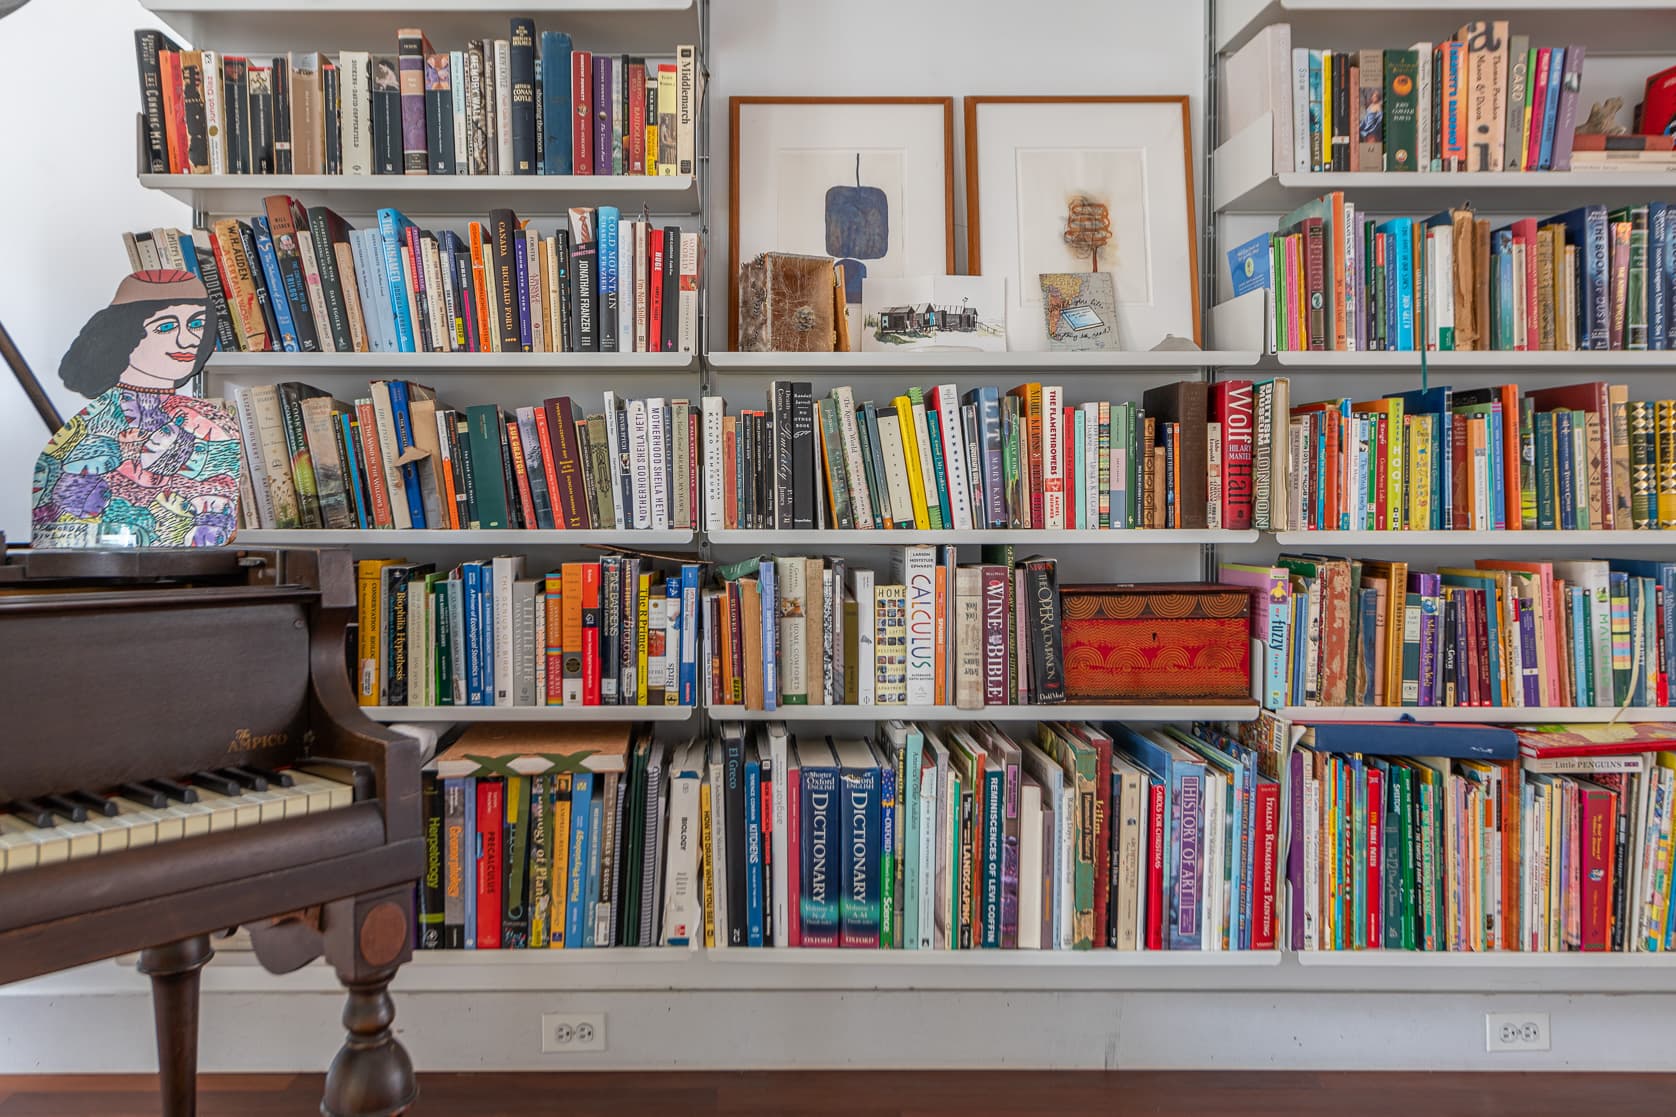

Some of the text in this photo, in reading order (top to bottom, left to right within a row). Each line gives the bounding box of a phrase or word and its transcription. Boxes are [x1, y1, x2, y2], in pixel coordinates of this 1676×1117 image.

[470, 54, 481, 122] MEMORY WALL
[681, 61, 691, 124] Middlemarch
[1448, 49, 1458, 144] GRAVITY'S RAINBOW
[1476, 55, 1485, 120] Mason & Dixon
[1492, 56, 1501, 120] Thomas Pynchon
[1512, 63, 1526, 102] CARD
[146, 72, 161, 150] THE CUNNING MAN
[383, 218, 400, 282] THE UNNAMED
[608, 216, 616, 309] COLD MOUNTAIN
[654, 252, 662, 271] HUGE
[1595, 223, 1605, 323] THE BOOK OF DUST
[202, 263, 228, 316] MIDDLESEX
[286, 274, 298, 301] TRILOGY
[498, 221, 513, 330] CANADA RICHARD FORD
[579, 260, 590, 332] JONATHAN FRANZEN
[333, 308, 341, 330] EGGERS
[638, 306, 646, 325] Stiller
[825, 409, 834, 434] johnson
[845, 410, 854, 432] Known
[984, 400, 1000, 441] LIT
[1049, 391, 1057, 406] THE
[1228, 385, 1252, 444] Wolf
[1264, 383, 1272, 444] BRITISH
[292, 402, 304, 452] COOKBOOK
[365, 425, 373, 437] THE
[367, 438, 375, 456] WIND
[510, 425, 524, 475] SUE GRAFTON
[778, 421, 792, 480] Pemberley
[849, 434, 857, 454] World
[370, 466, 378, 478] THE
[635, 413, 647, 522] MOTHERHOOD SHEILA HETI
[651, 408, 664, 516] MOTHERHOOD SHEILA HETI
[992, 456, 1001, 514] MARY KARR
[1228, 463, 1252, 504] Hall
[1543, 469, 1551, 498] LIGHTNING
[373, 479, 382, 507] WILLOWS
[778, 485, 786, 506] James
[1256, 446, 1270, 528] LONDON
[1543, 500, 1551, 516] THIEF
[609, 572, 619, 636] PINE BARRENS
[639, 588, 648, 599] The
[987, 583, 1004, 629] WINE
[524, 607, 533, 650] LITTLE
[623, 616, 636, 665] BIOLOGY
[639, 620, 648, 655] Primer
[912, 574, 931, 668] CALCULUS
[1038, 574, 1055, 680] THE OPERA COMPANION
[1269, 620, 1286, 651] fuzzy
[524, 656, 533, 682] LIFE
[665, 663, 674, 688] Birds
[987, 645, 1004, 698] BIBLE
[1447, 650, 1455, 669] Giver
[728, 747, 739, 789] El Greco
[807, 777, 835, 786] Oxford
[1555, 760, 1622, 770] Little PENGUINS
[680, 816, 688, 851] BIOLOGY
[704, 830, 712, 842] TO
[749, 823, 759, 864] KITCHENS
[812, 792, 829, 904] DICTIONARY
[851, 791, 868, 904] DICTIONARY
[1154, 786, 1164, 869] CAROLS FOR CHRISTMAS
[1182, 786, 1196, 896] HISTORY OF ART
[427, 817, 440, 888] Herpetology
[448, 826, 462, 897] Geomorphology
[487, 831, 495, 895] PRECALCULUS
[604, 857, 611, 867] OF
[987, 777, 998, 943] REMINISCENCES OF LEVI COFFIN
[1262, 797, 1275, 937] ITALIAN RENAISSANCE PAINTING
[962, 845, 971, 924] LANDSCAPING
[804, 936, 832, 944] OXFORD
[846, 936, 874, 944] OXFORD
